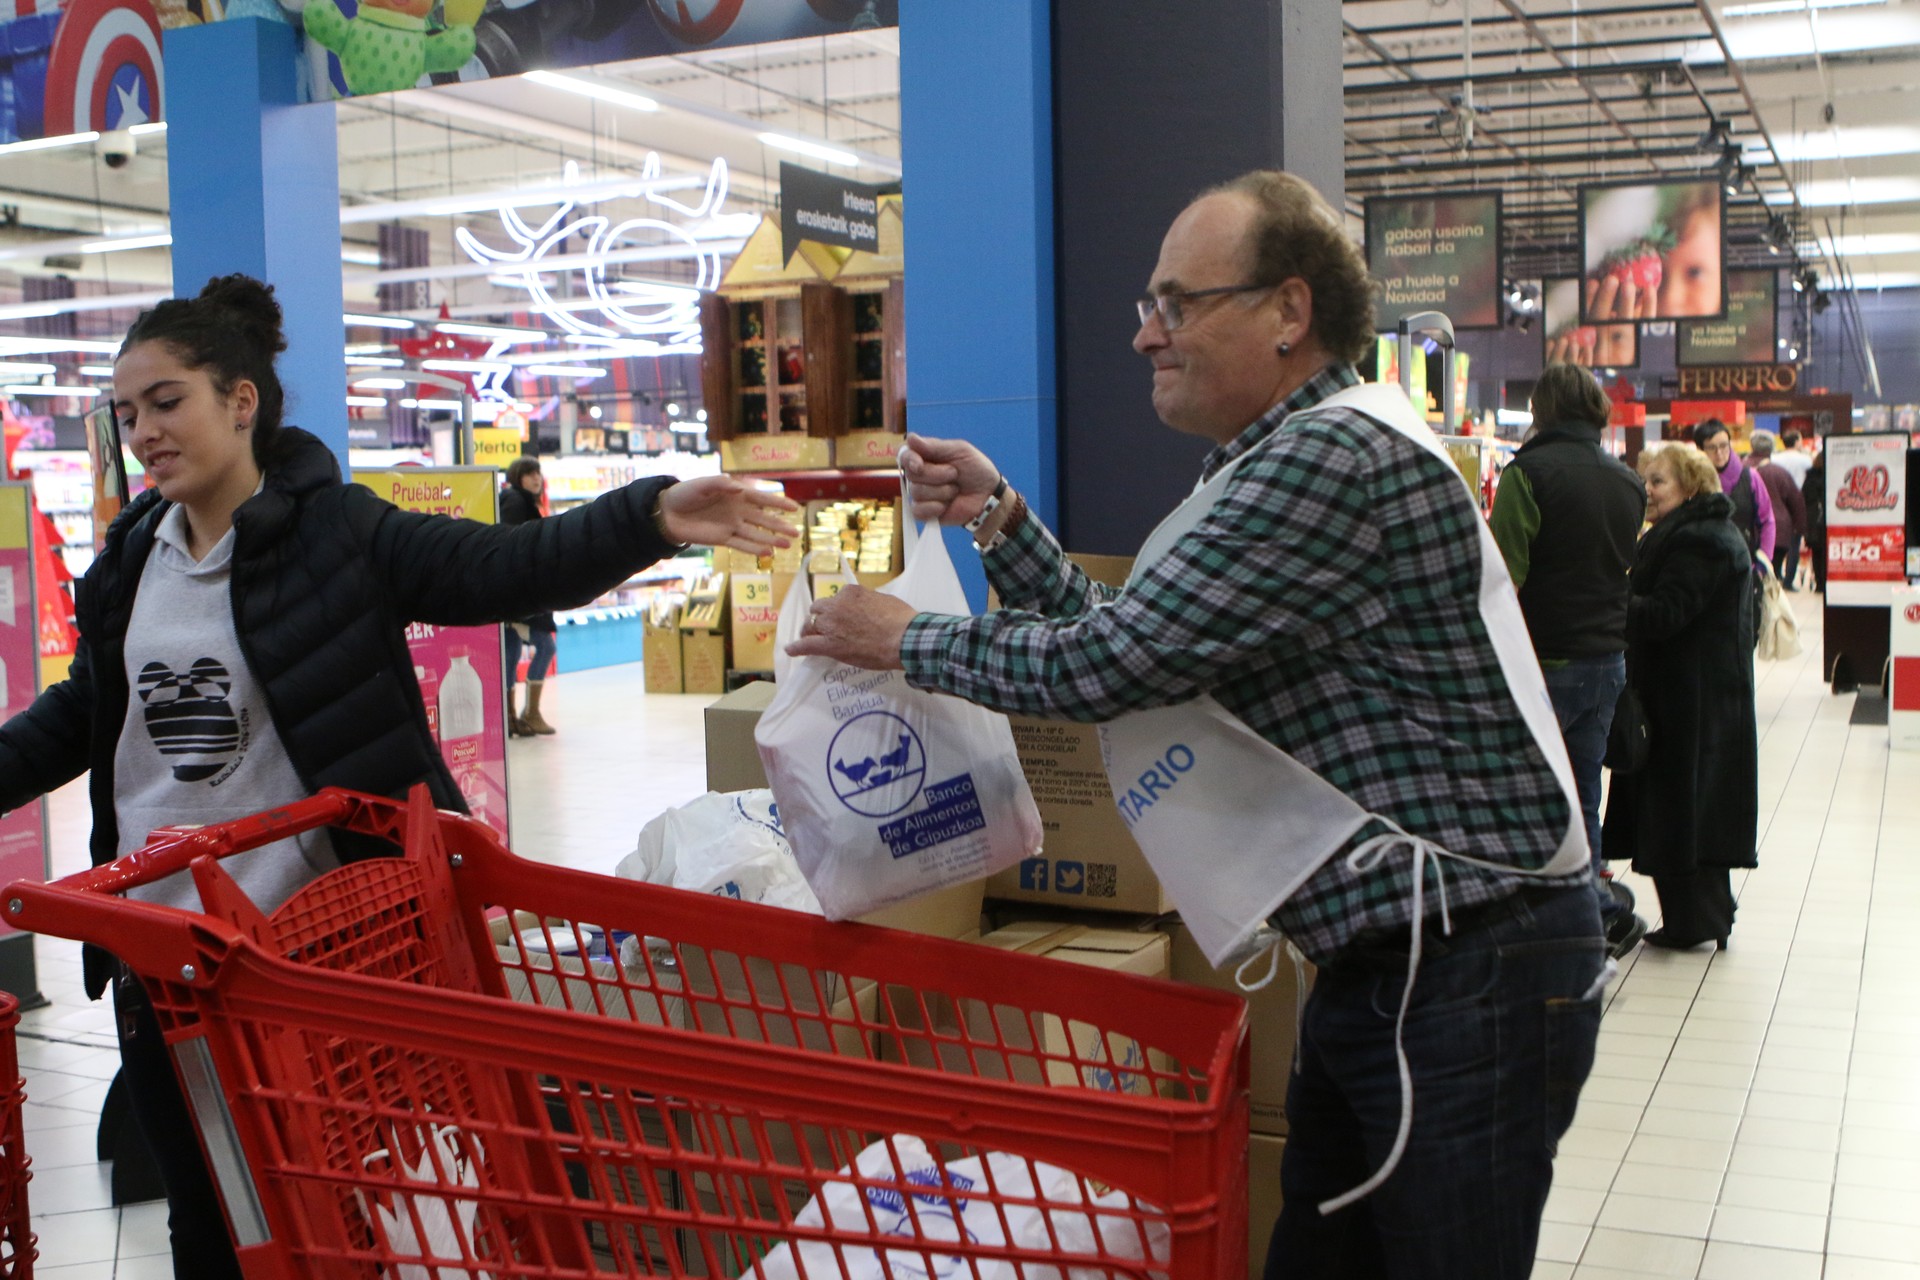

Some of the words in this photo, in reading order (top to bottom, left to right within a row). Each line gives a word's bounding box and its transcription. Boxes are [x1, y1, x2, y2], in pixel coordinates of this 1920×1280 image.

[843, 189, 876, 215] Irteera
[796, 208, 848, 234] erosketarik
[849, 219, 876, 240] gabe
[1385, 228, 1432, 244] gabon
[1436, 224, 1484, 239] usaina
[1385, 242, 1431, 256] nabari
[1435, 241, 1455, 254] da
[1385, 278, 1402, 291] ya
[1406, 274, 1445, 288] huele
[1449, 275, 1460, 287] a
[1385, 288, 1446, 304] Navidad
[1680, 364, 1797, 394] FERRERO
[1828, 542, 1881, 561] BEZ-a
[827, 671, 895, 703] Elikagaien
[832, 694, 884, 721] Bankua
[925, 780, 972, 805] Banco
[883, 825, 902, 841] de
[904, 799, 978, 835] Alimentos
[892, 841, 912, 856] de
[914, 816, 983, 848] Gipuzkoa
